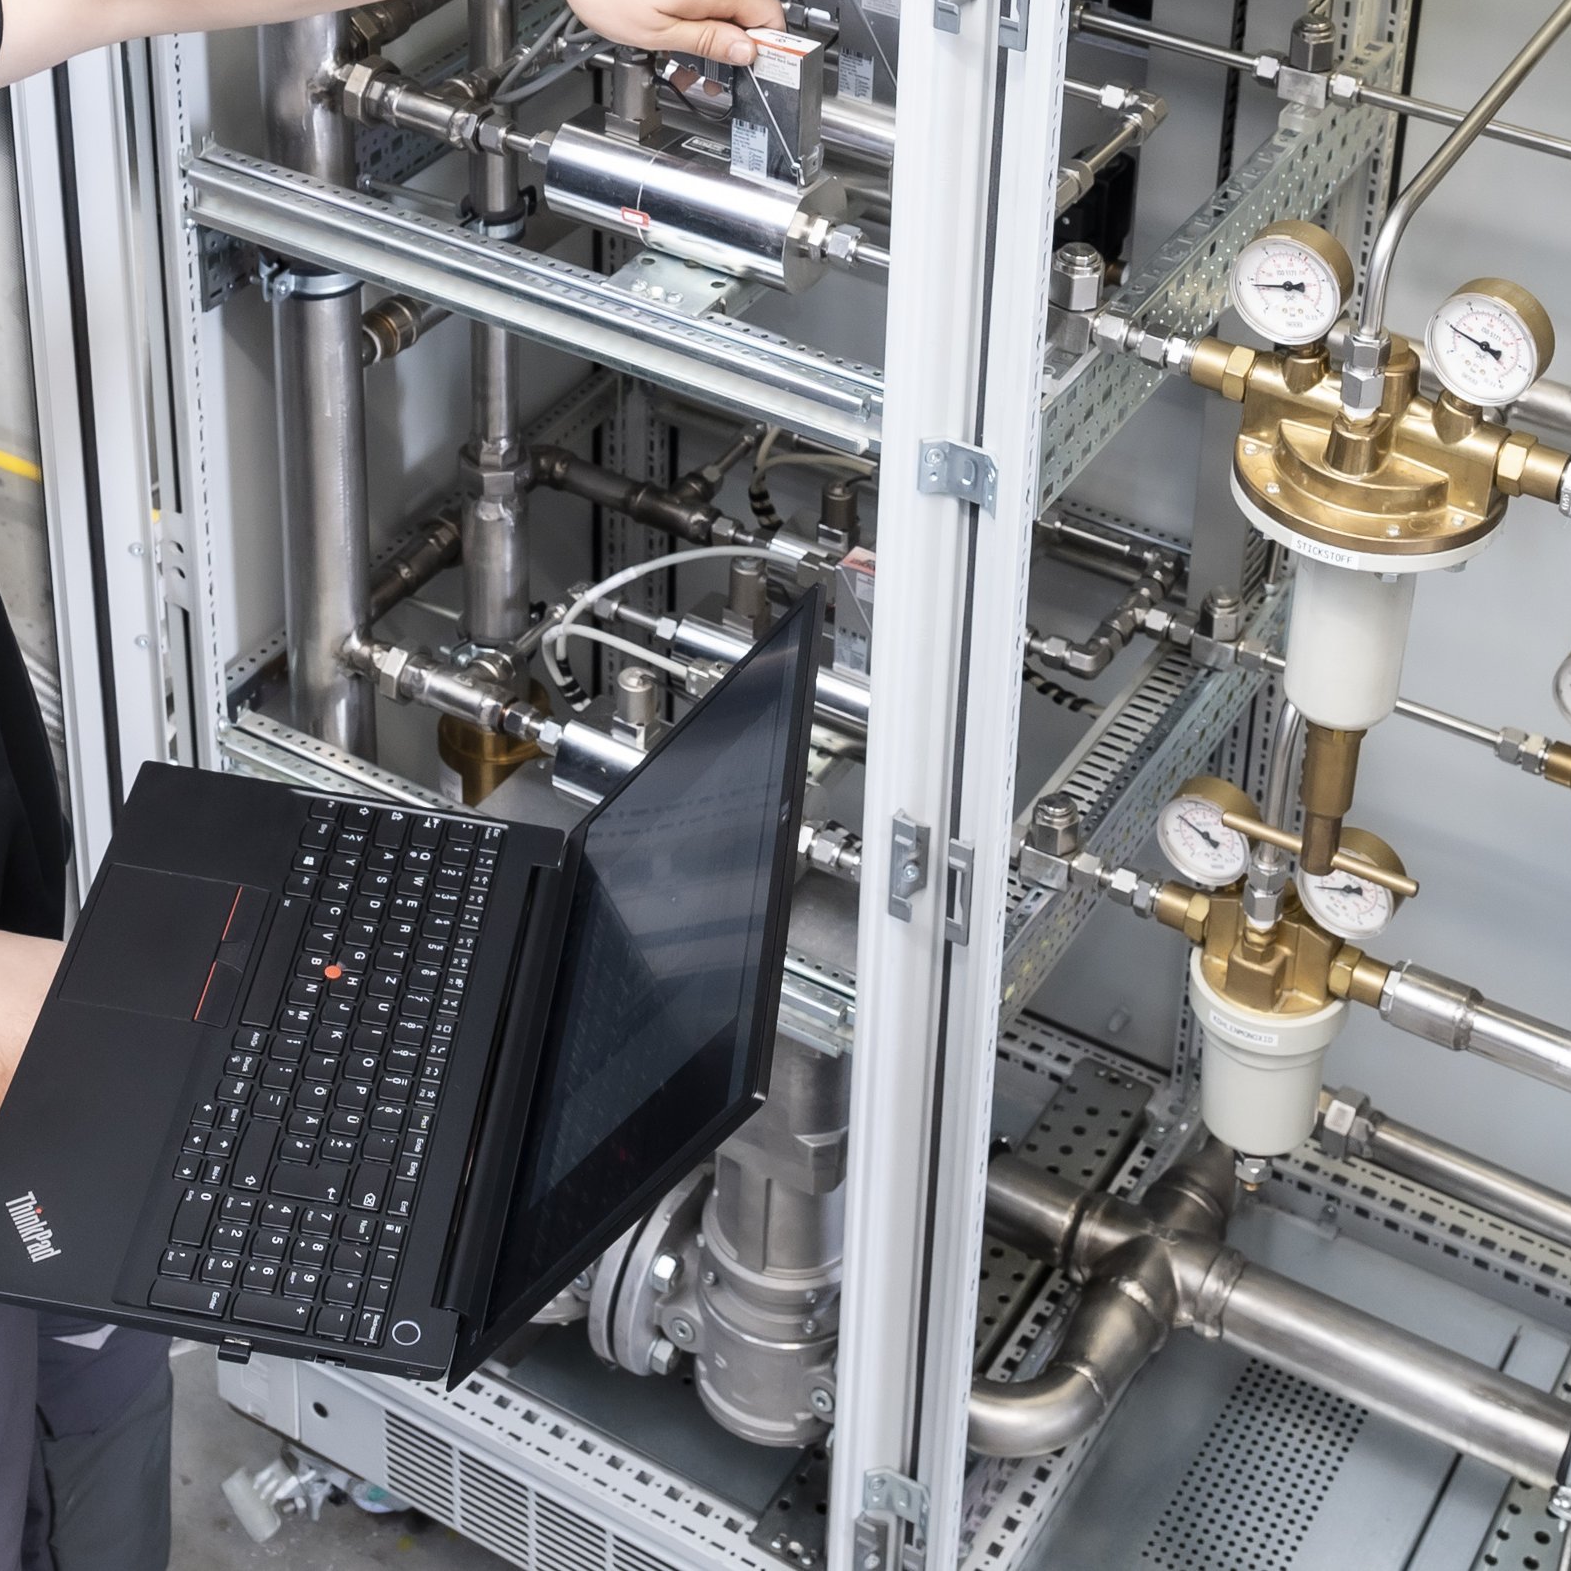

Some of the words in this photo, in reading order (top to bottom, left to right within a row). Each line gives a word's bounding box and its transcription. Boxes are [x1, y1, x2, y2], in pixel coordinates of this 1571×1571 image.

[1296, 539, 1354, 565] STICKSTOFF
[383, 852, 394, 861] A
[418, 852, 431, 861] Q
[345, 858, 356, 867] Y
[376, 875, 388, 884] S
[413, 876, 425, 887] W
[337, 882, 350, 891] X
[369, 900, 381, 909] D
[407, 899, 418, 908] E
[330, 907, 342, 916] C
[363, 925, 374, 934] F
[399, 924, 412, 934] R
[322, 932, 334, 941] V
[354, 951, 366, 961] G
[393, 951, 405, 960] T
[311, 957, 323, 966] B
[347, 976, 359, 986] H
[385, 976, 397, 986] Z
[306, 983, 318, 993] N
[339, 1003, 351, 1012] J
[378, 1002, 390, 1012] U
[298, 1010, 309, 1020] M
[331, 1030, 343, 1039] K
[323, 1057, 335, 1065] L
[362, 1057, 374, 1068] O
[314, 1086, 327, 1096] Ö
[356, 1085, 367, 1095] P
[305, 1114, 319, 1125] Ä
[346, 1114, 360, 1124] Ü
[201, 1192, 213, 1202] 0
[280, 1205, 293, 1215] 4
[321, 1212, 333, 1222] 7
[5, 1190, 62, 1264] ThinkPad
[231, 1229, 244, 1239] 2
[271, 1236, 284, 1246] 5
[312, 1243, 325, 1253] 8
[222, 1260, 234, 1270] 3
[262, 1267, 275, 1277] 6
[303, 1273, 316, 1283] 9
[208, 1290, 221, 1311] Enter
